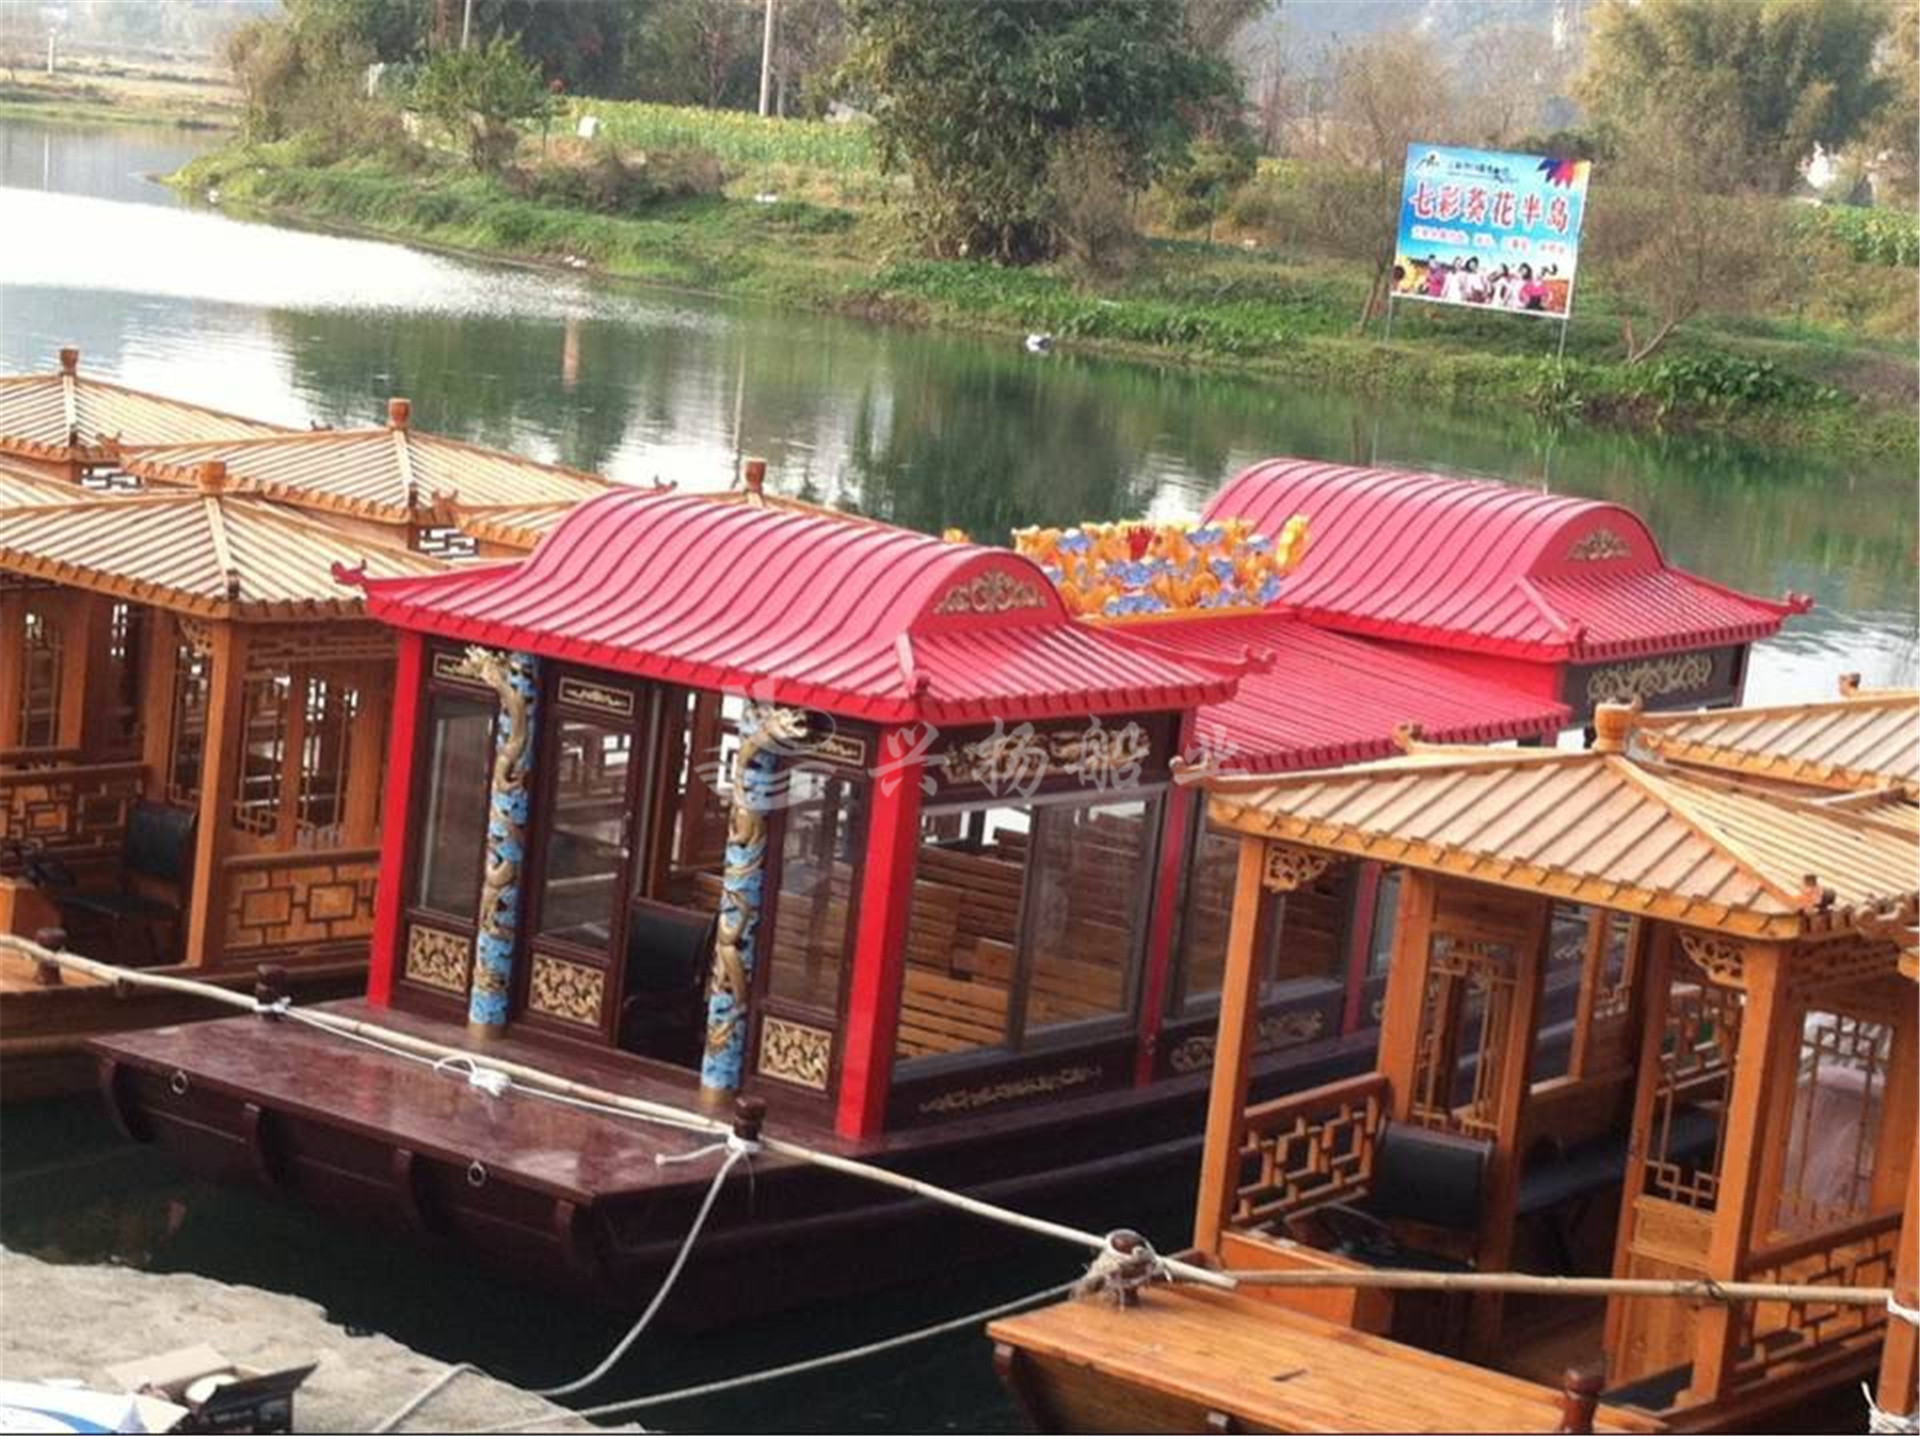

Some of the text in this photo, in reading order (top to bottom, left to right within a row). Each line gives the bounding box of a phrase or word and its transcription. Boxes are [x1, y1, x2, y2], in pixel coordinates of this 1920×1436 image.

[1411, 182, 1569, 233] 七彩葵花半岛
